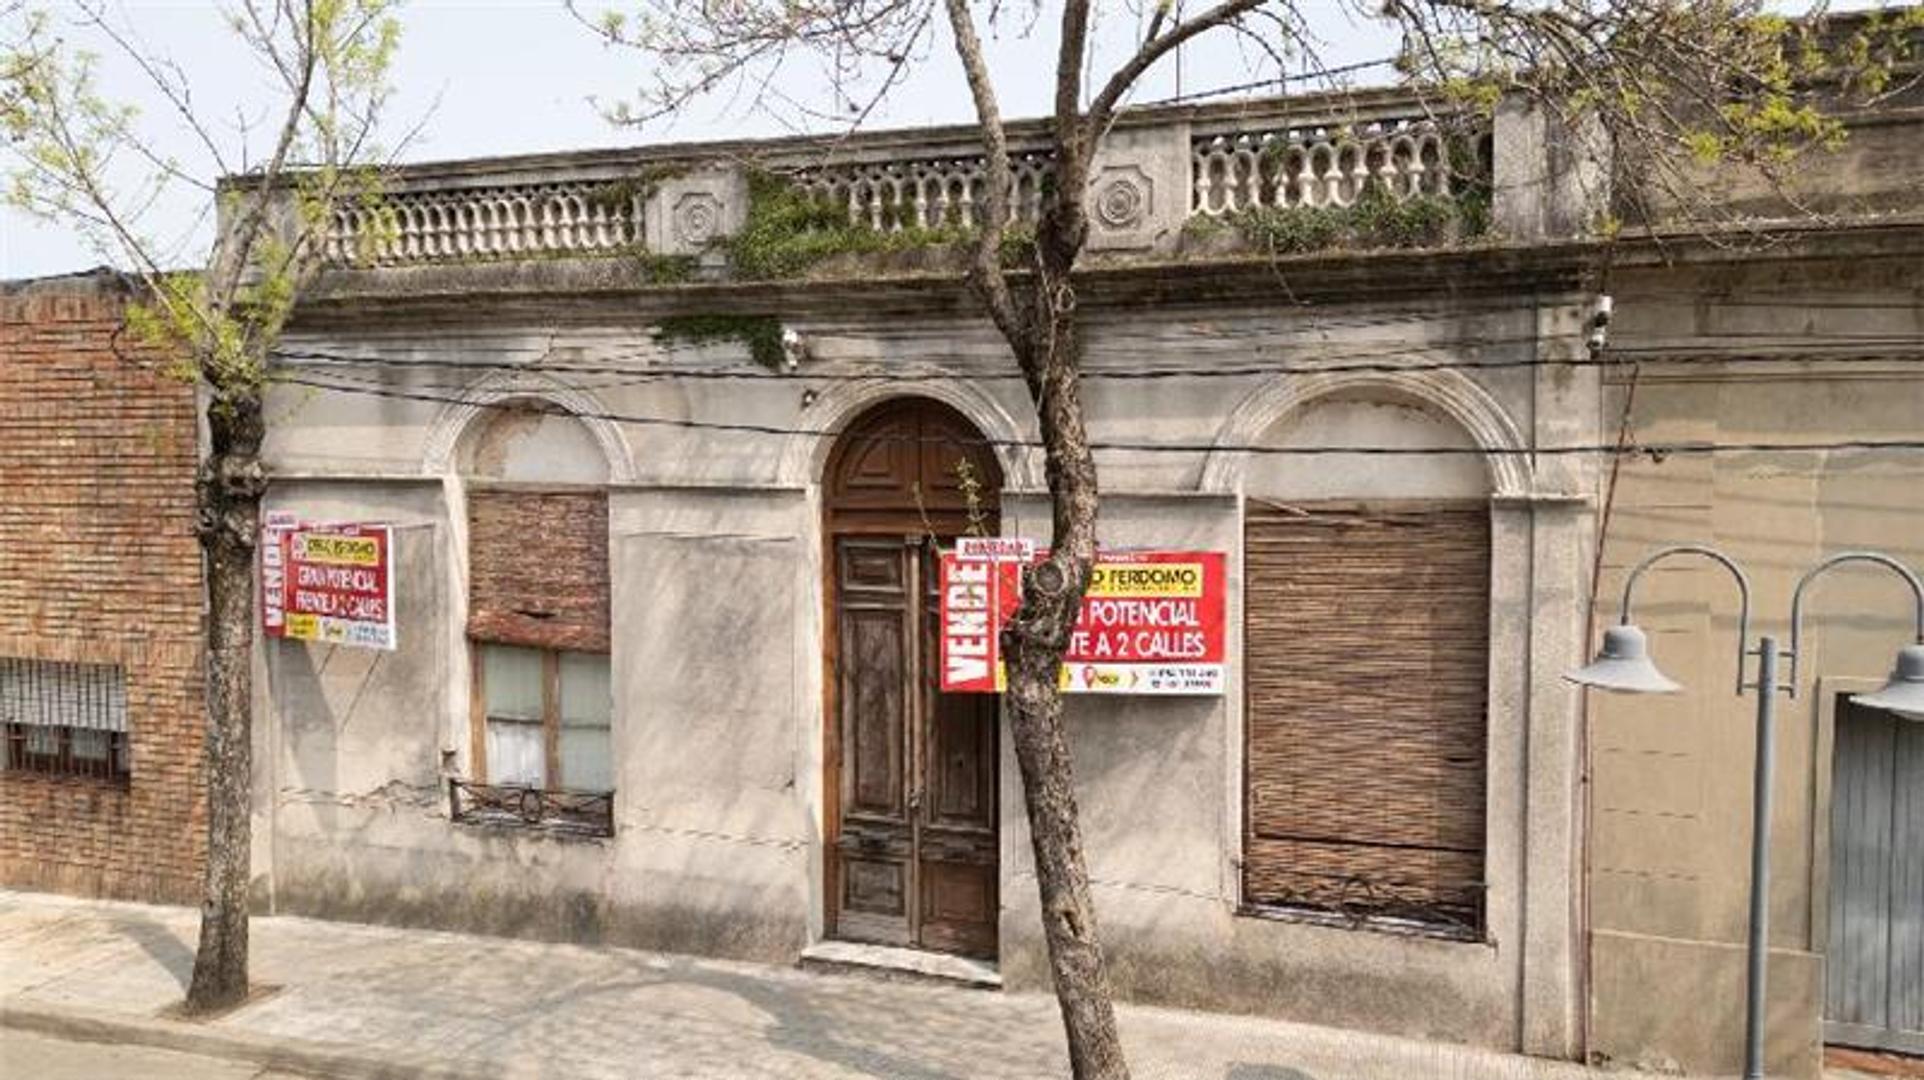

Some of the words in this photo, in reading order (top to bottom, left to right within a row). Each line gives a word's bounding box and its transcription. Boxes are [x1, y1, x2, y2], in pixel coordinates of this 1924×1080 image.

[263, 527, 283, 626] VENDE
[946, 562, 988, 684] VENDE
[1090, 600, 1200, 627] POTENCIAL
[1095, 632, 1112, 656] A
[1116, 632, 1130, 656] 2
[1134, 631, 1206, 657] CALLES
